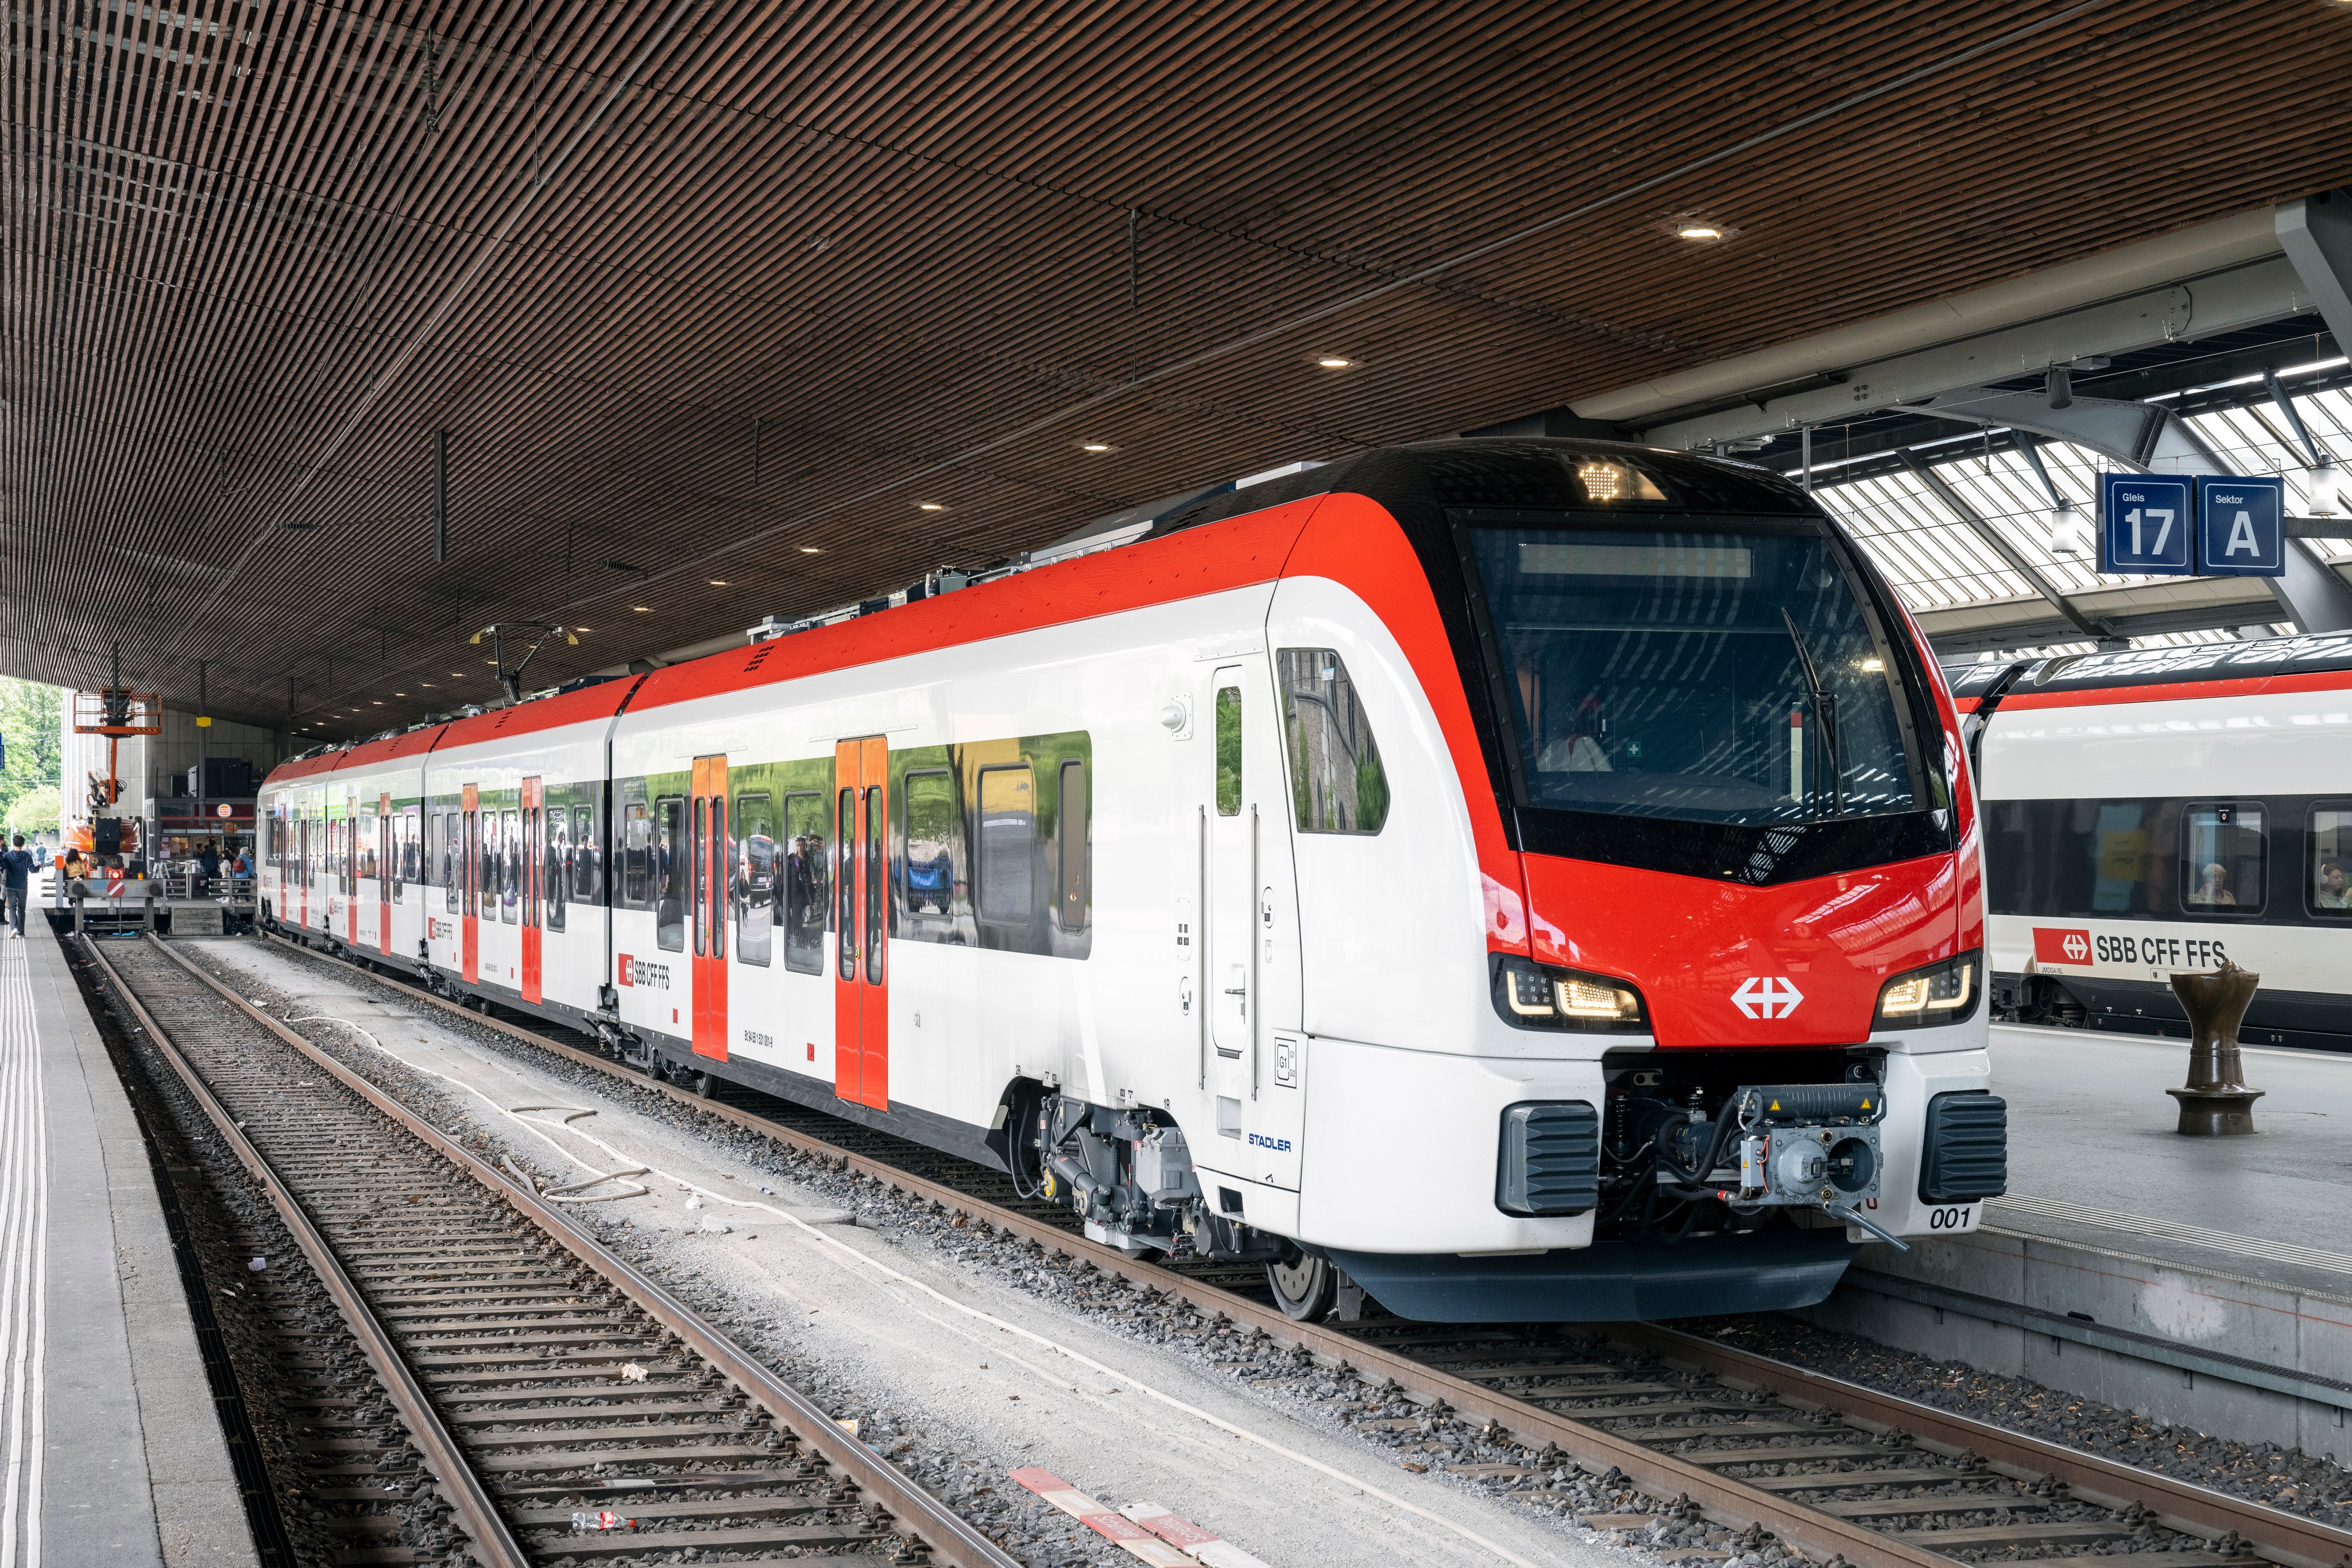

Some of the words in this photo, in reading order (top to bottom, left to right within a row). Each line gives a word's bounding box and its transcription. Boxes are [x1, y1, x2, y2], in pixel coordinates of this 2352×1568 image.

[2122, 493, 2145, 502] Gleis
[2215, 495, 2243, 504] Sektor
[2125, 508, 2175, 555] 17
[2225, 510, 2260, 557] A
[2096, 935, 2137, 963] SBB
[2141, 938, 2180, 966] CFF
[2185, 940, 2226, 968] FFS
[635, 960, 646, 985] SBB
[647, 962, 657, 988] CFF
[659, 964, 670, 990] FFS
[1279, 1056, 1287, 1068] G1
[1290, 1050, 1295, 1059] G1
[1016, 1064, 1021, 1075] 2R
[1164, 1098, 1170, 1111] 1R
[1249, 1133, 1291, 1153] STADLER
[1930, 1207, 1970, 1229] 001
